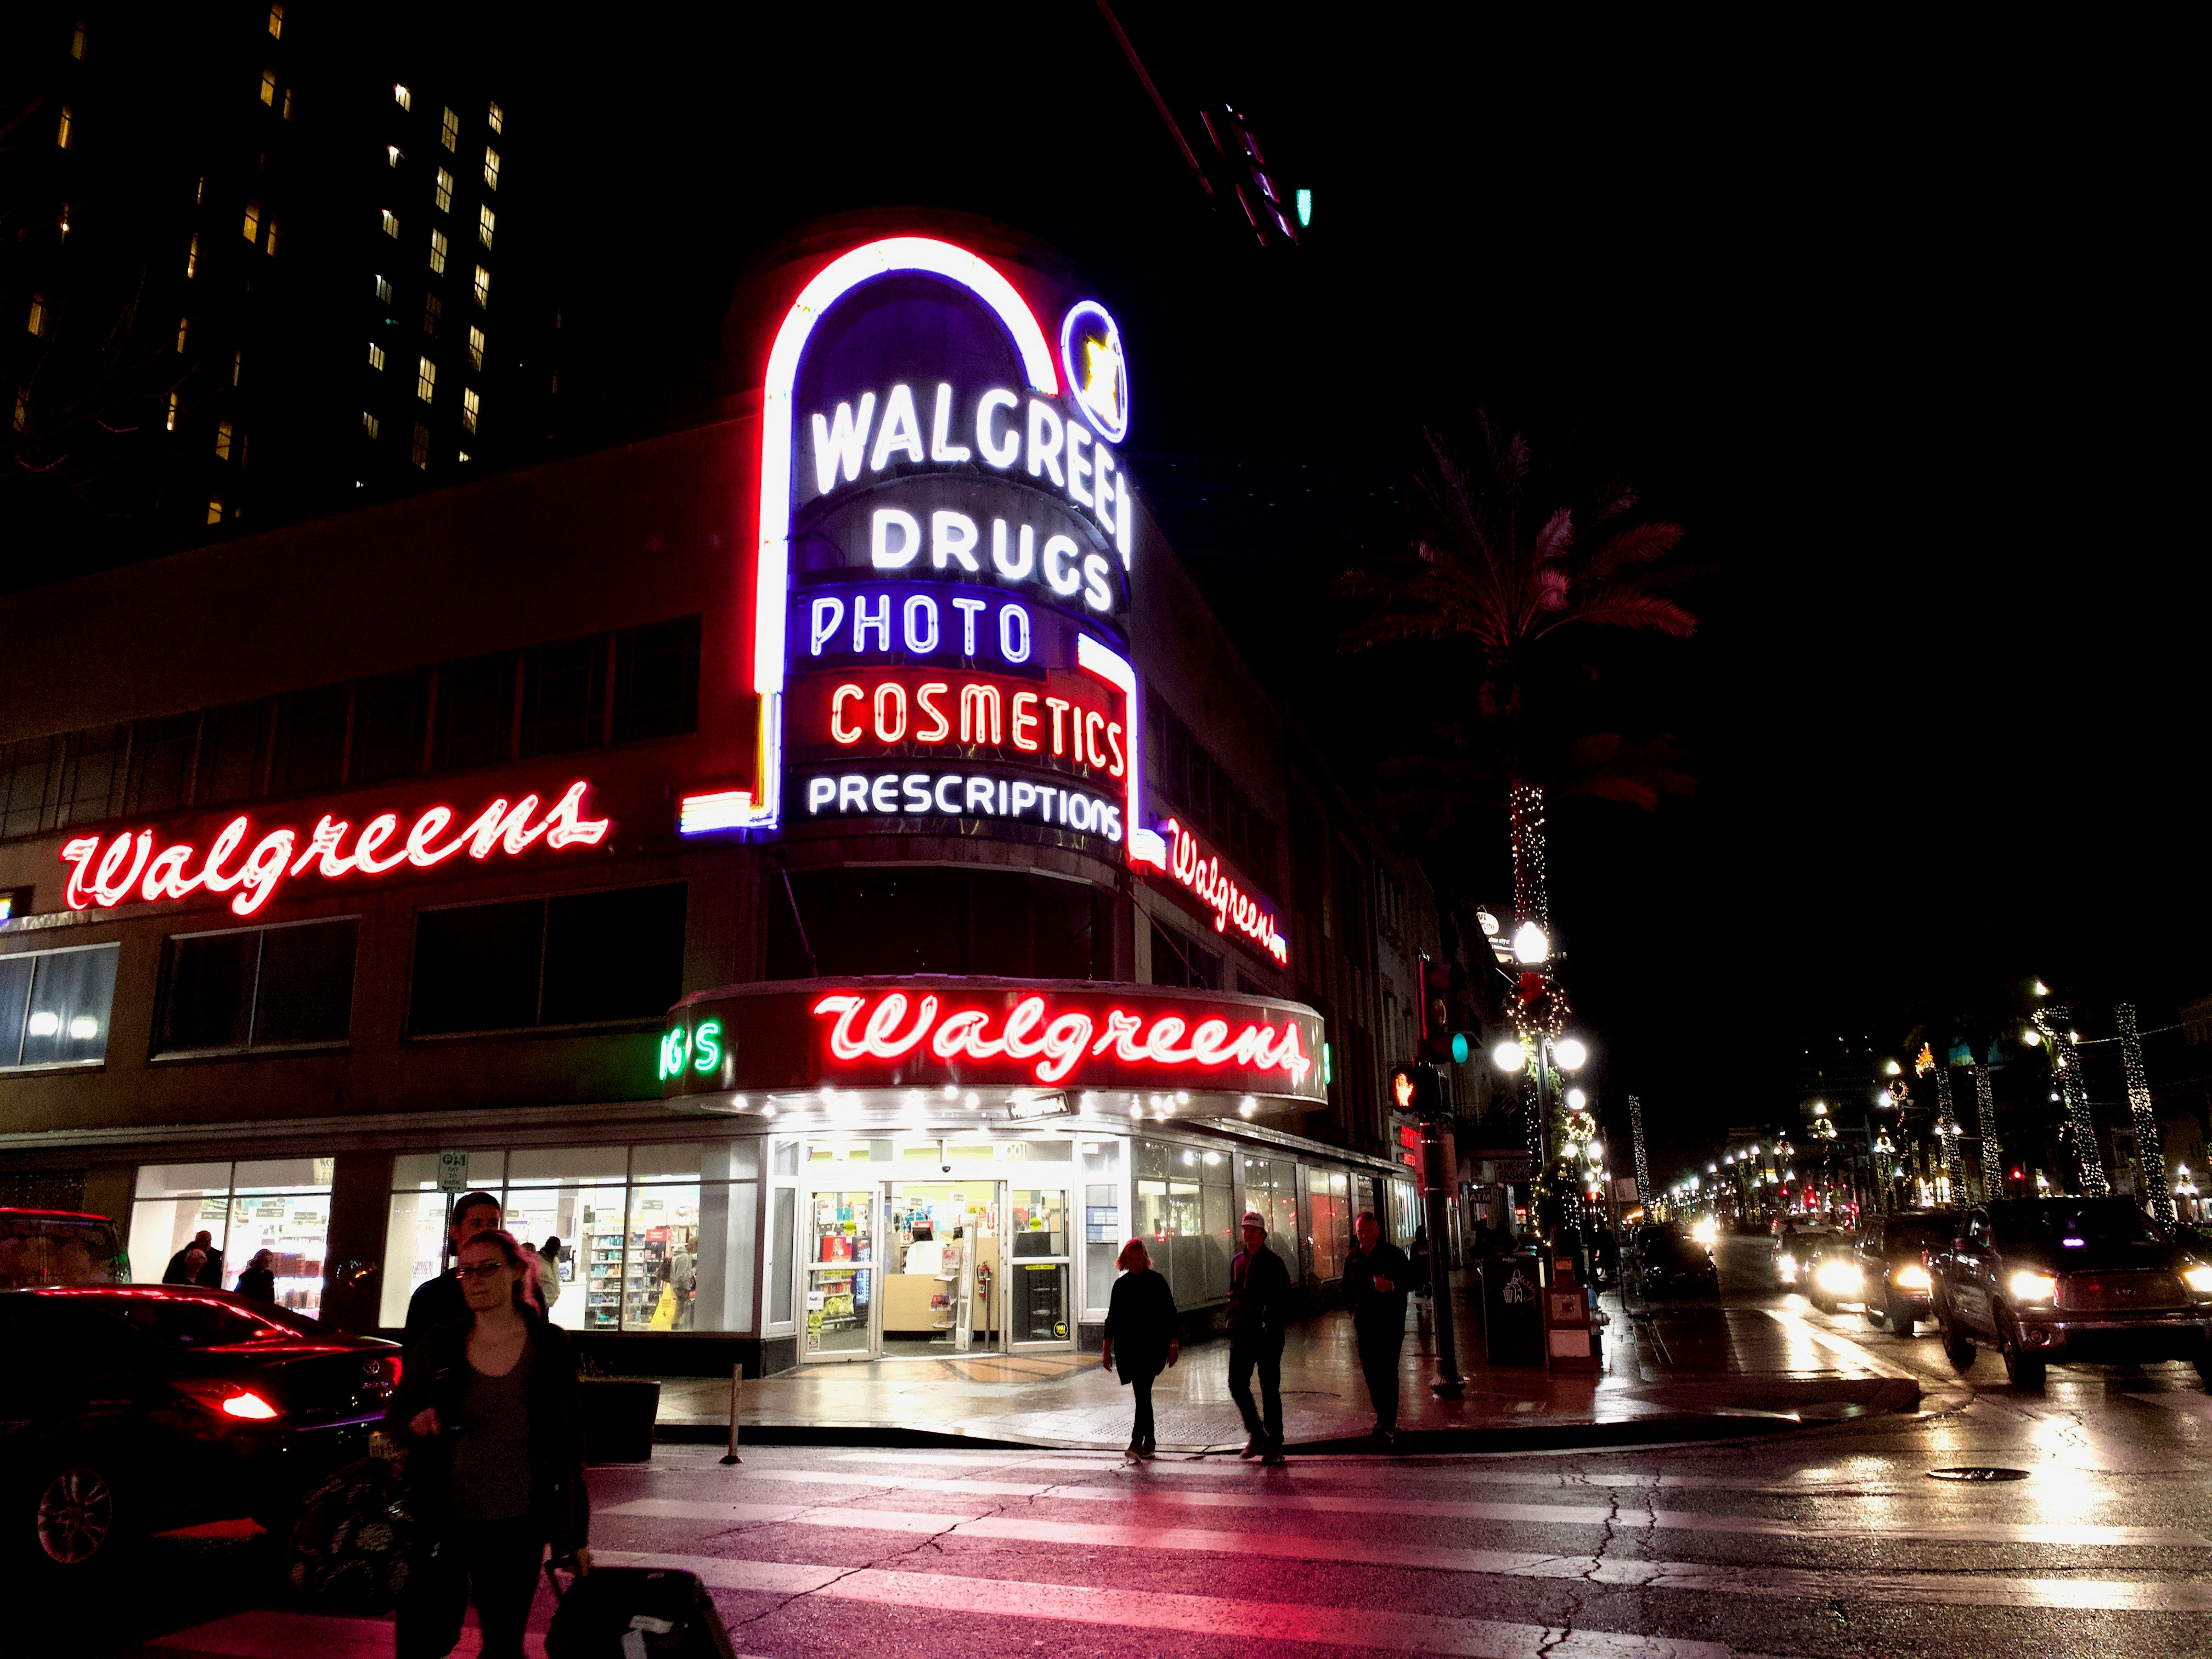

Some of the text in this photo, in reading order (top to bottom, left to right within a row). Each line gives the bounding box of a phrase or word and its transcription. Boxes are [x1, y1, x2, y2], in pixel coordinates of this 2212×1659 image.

[871, 508, 1113, 611] DRUGS
[810, 594, 1031, 663] PHOTO
[831, 682, 1125, 777] COSMETICS
[59, 780, 610, 916] Walgreens
[808, 773, 1123, 843] PRESCRIPTIONS
[1167, 817, 1287, 964] Walgreens
[814, 992, 1311, 1084] Walgreens
[1470, 1193, 1491, 1202] ATM
